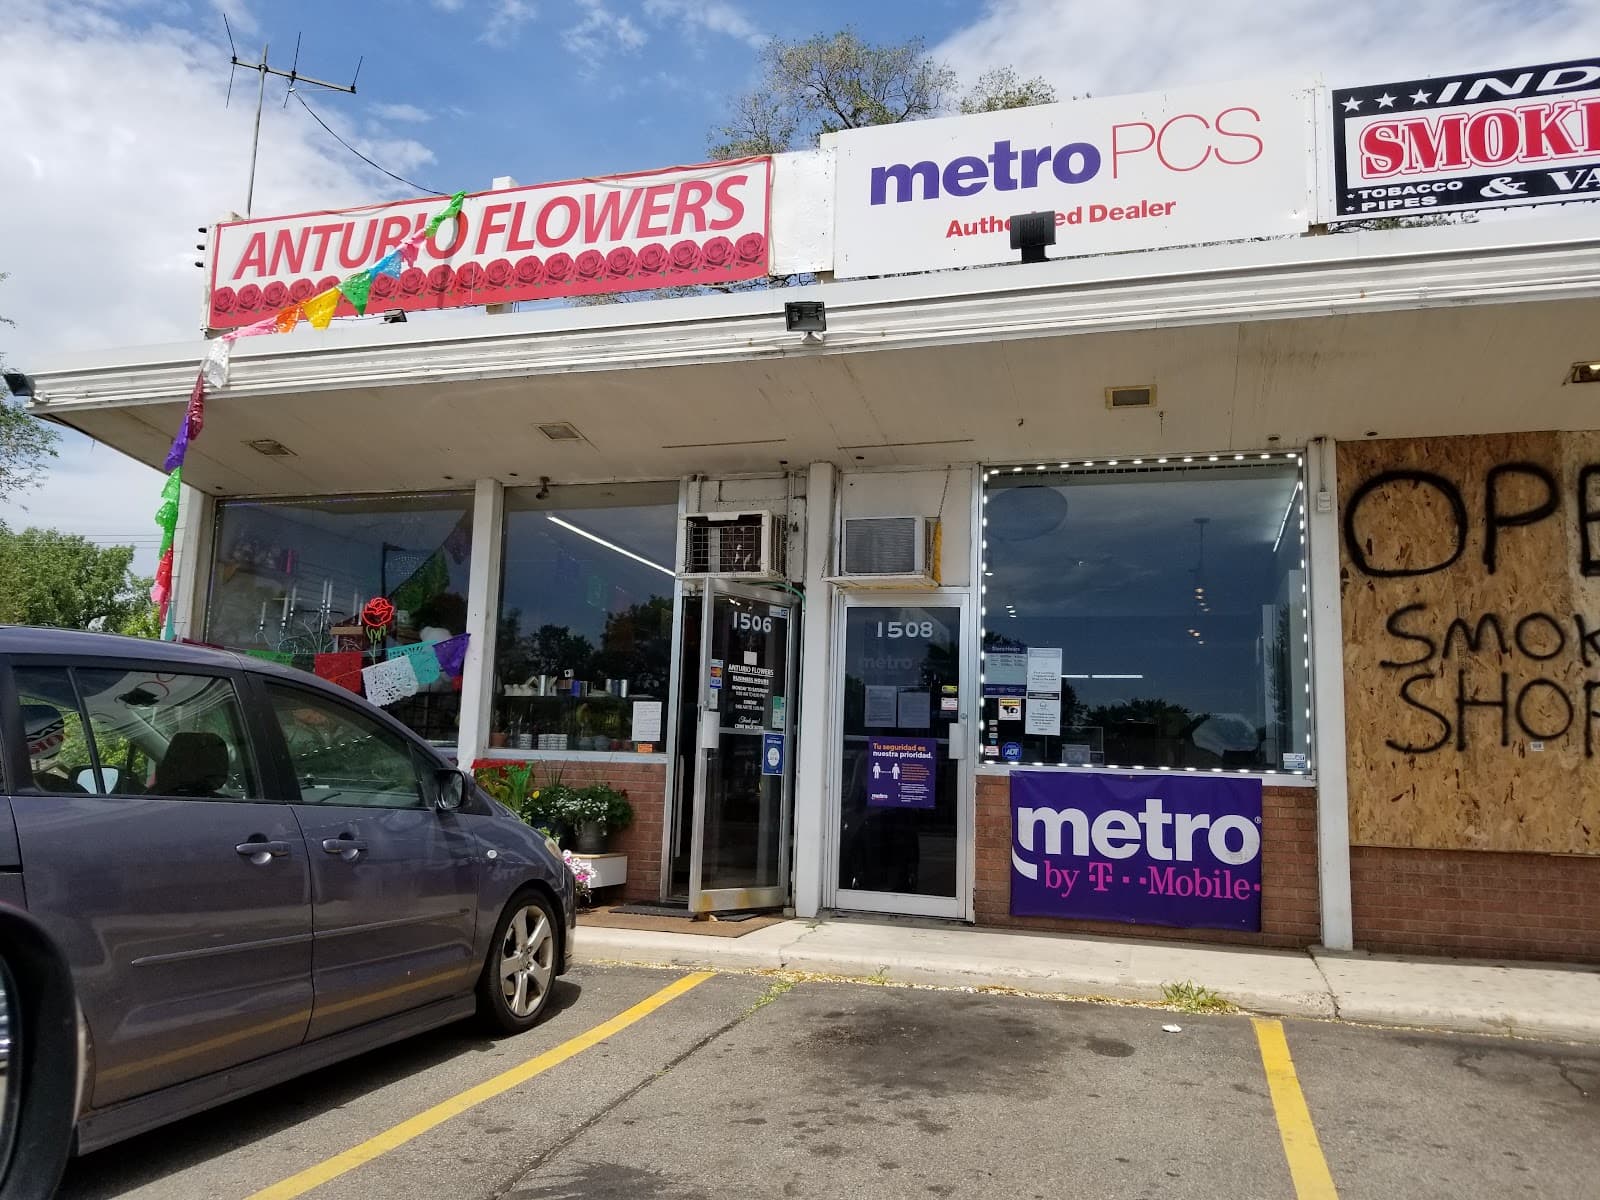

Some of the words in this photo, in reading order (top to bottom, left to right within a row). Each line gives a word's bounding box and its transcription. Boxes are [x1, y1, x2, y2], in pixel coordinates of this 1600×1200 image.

[1436, 65, 1600, 103] IND
[1358, 180, 1464, 199] TOBACCO
[1479, 176, 1528, 198] &
[1361, 195, 1438, 212] PIPES
[233, 208, 469, 280] ANTURIO
[474, 175, 748, 256] FLOWERS
[945, 203, 1083, 239] Authed
[1089, 200, 1177, 224] Dealer
[732, 610, 772, 633] 1506
[876, 621, 933, 638] 1508
[752, 666, 774, 676] FLOWERS
[882, 743, 916, 752] seguridad
[1005, 748, 1020, 756] ADT
[1044, 860, 1080, 898] by
